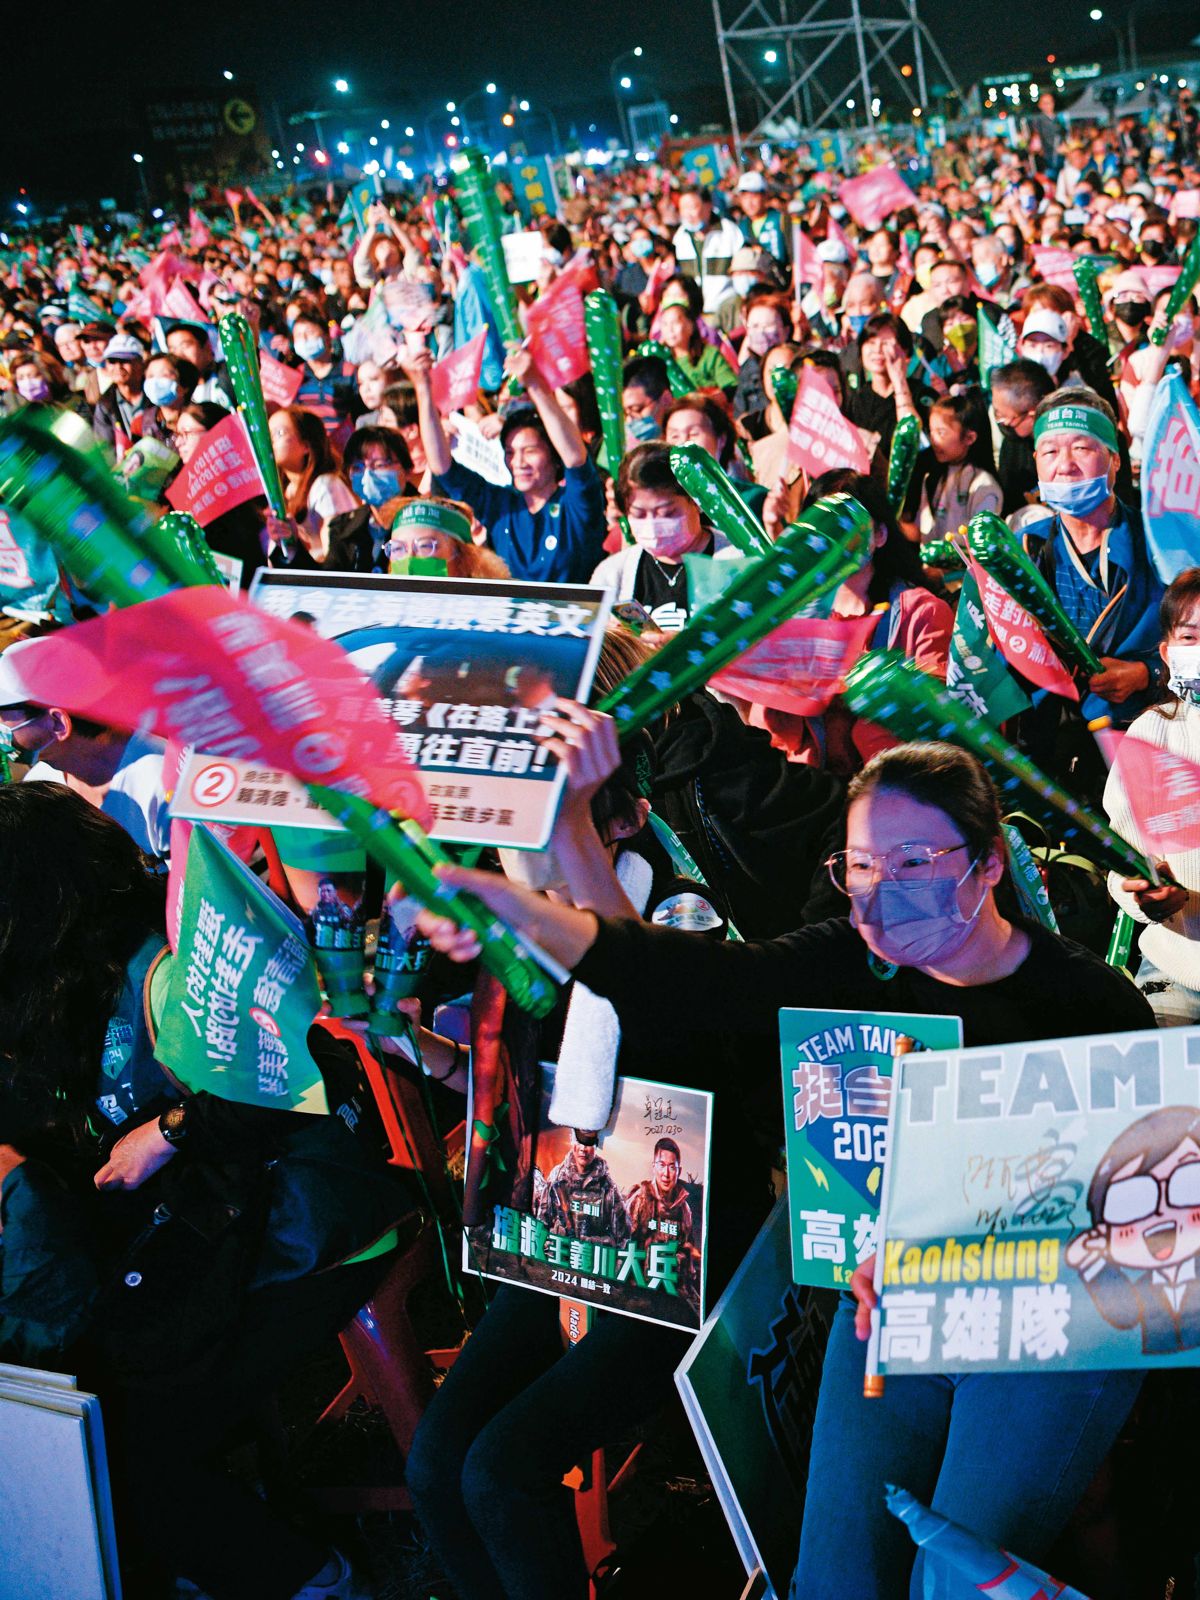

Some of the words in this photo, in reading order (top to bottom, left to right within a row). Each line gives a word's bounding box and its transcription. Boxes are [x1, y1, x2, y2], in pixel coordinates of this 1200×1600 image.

[797, 1025, 855, 1062] TEAM
[899, 1038, 1165, 1125] TEAM
[492, 1204, 679, 1296] 搶救王義川大兵
[883, 1235, 1060, 1285] Kaohsiung
[551, 1269, 577, 1286] 2024
[568, 1306, 581, 1339] Made
[879, 1284, 1072, 1363] 高雄隊
